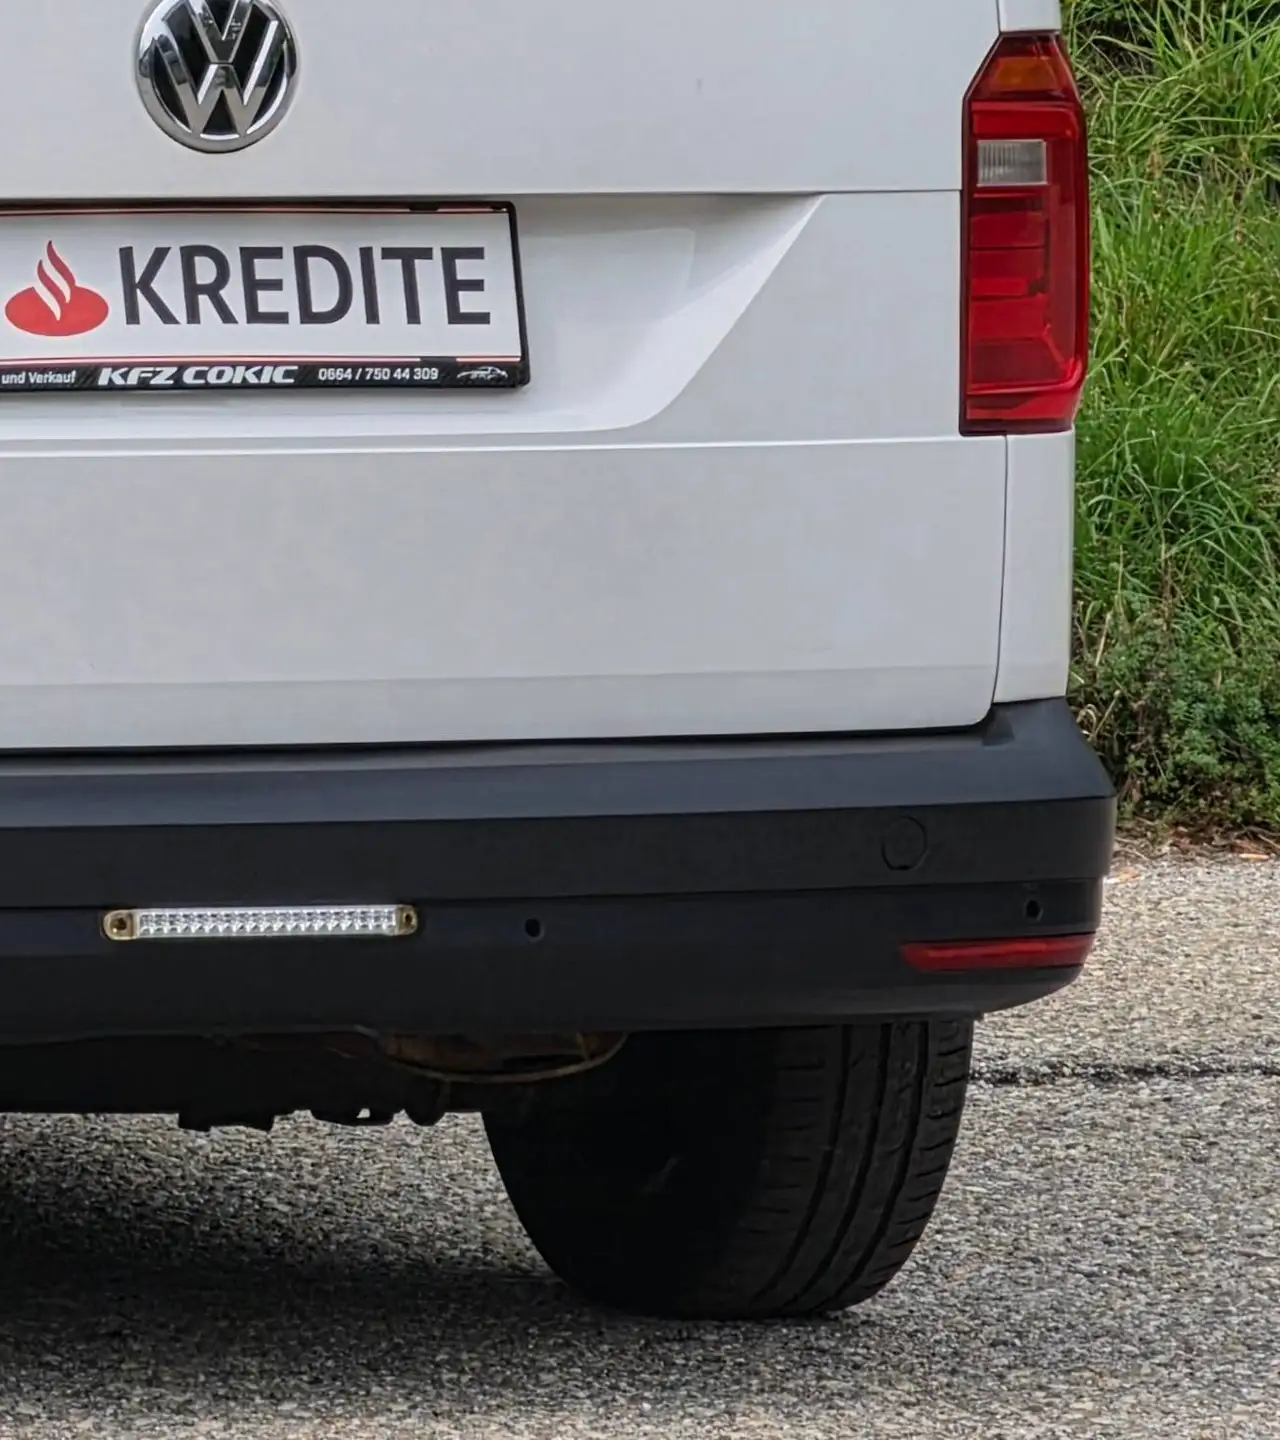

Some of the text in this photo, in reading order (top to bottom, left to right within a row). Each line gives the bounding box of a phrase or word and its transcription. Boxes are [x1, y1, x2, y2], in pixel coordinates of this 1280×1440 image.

[118, 244, 491, 326] KREDITE
[2, 371, 25, 385] und
[28, 370, 77, 385] Verkauf
[97, 366, 175, 386] KFZ
[182, 365, 299, 385] COKIC
[317, 367, 352, 381] 0664
[364, 367, 389, 381] 750
[392, 367, 411, 381] 44
[412, 367, 439, 381] 309
